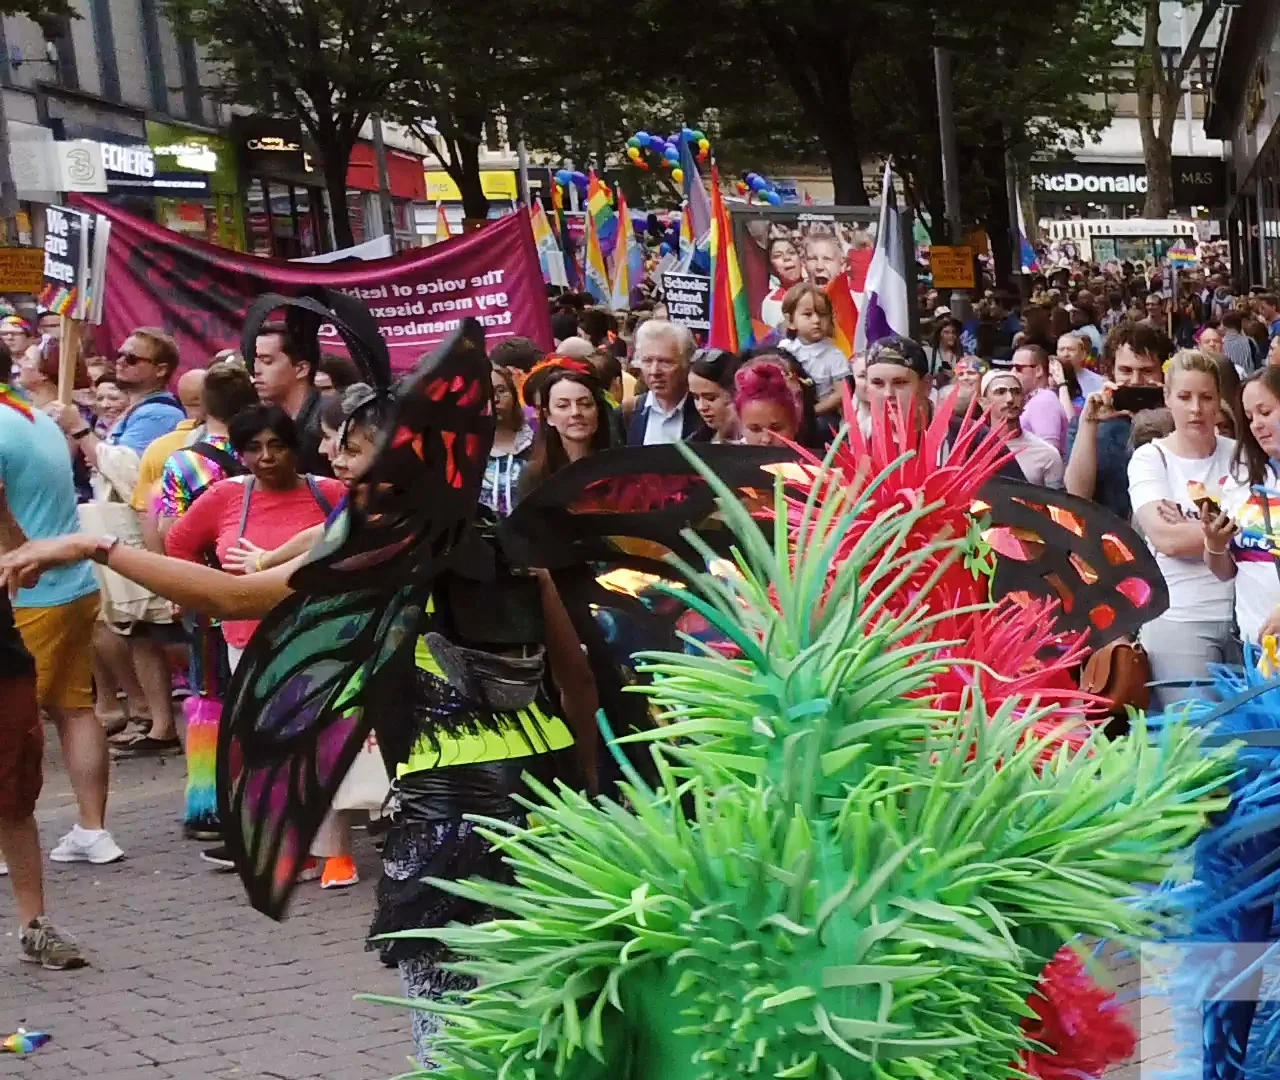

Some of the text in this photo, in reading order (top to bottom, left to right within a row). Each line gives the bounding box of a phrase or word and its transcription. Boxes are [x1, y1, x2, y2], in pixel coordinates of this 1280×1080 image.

[1031, 172, 1149, 193] McDonald
[1181, 171, 1213, 185] M&S
[45, 208, 69, 237] We
[44, 234, 69, 257] are
[43, 251, 75, 284] here
[666, 289, 704, 304] defend
